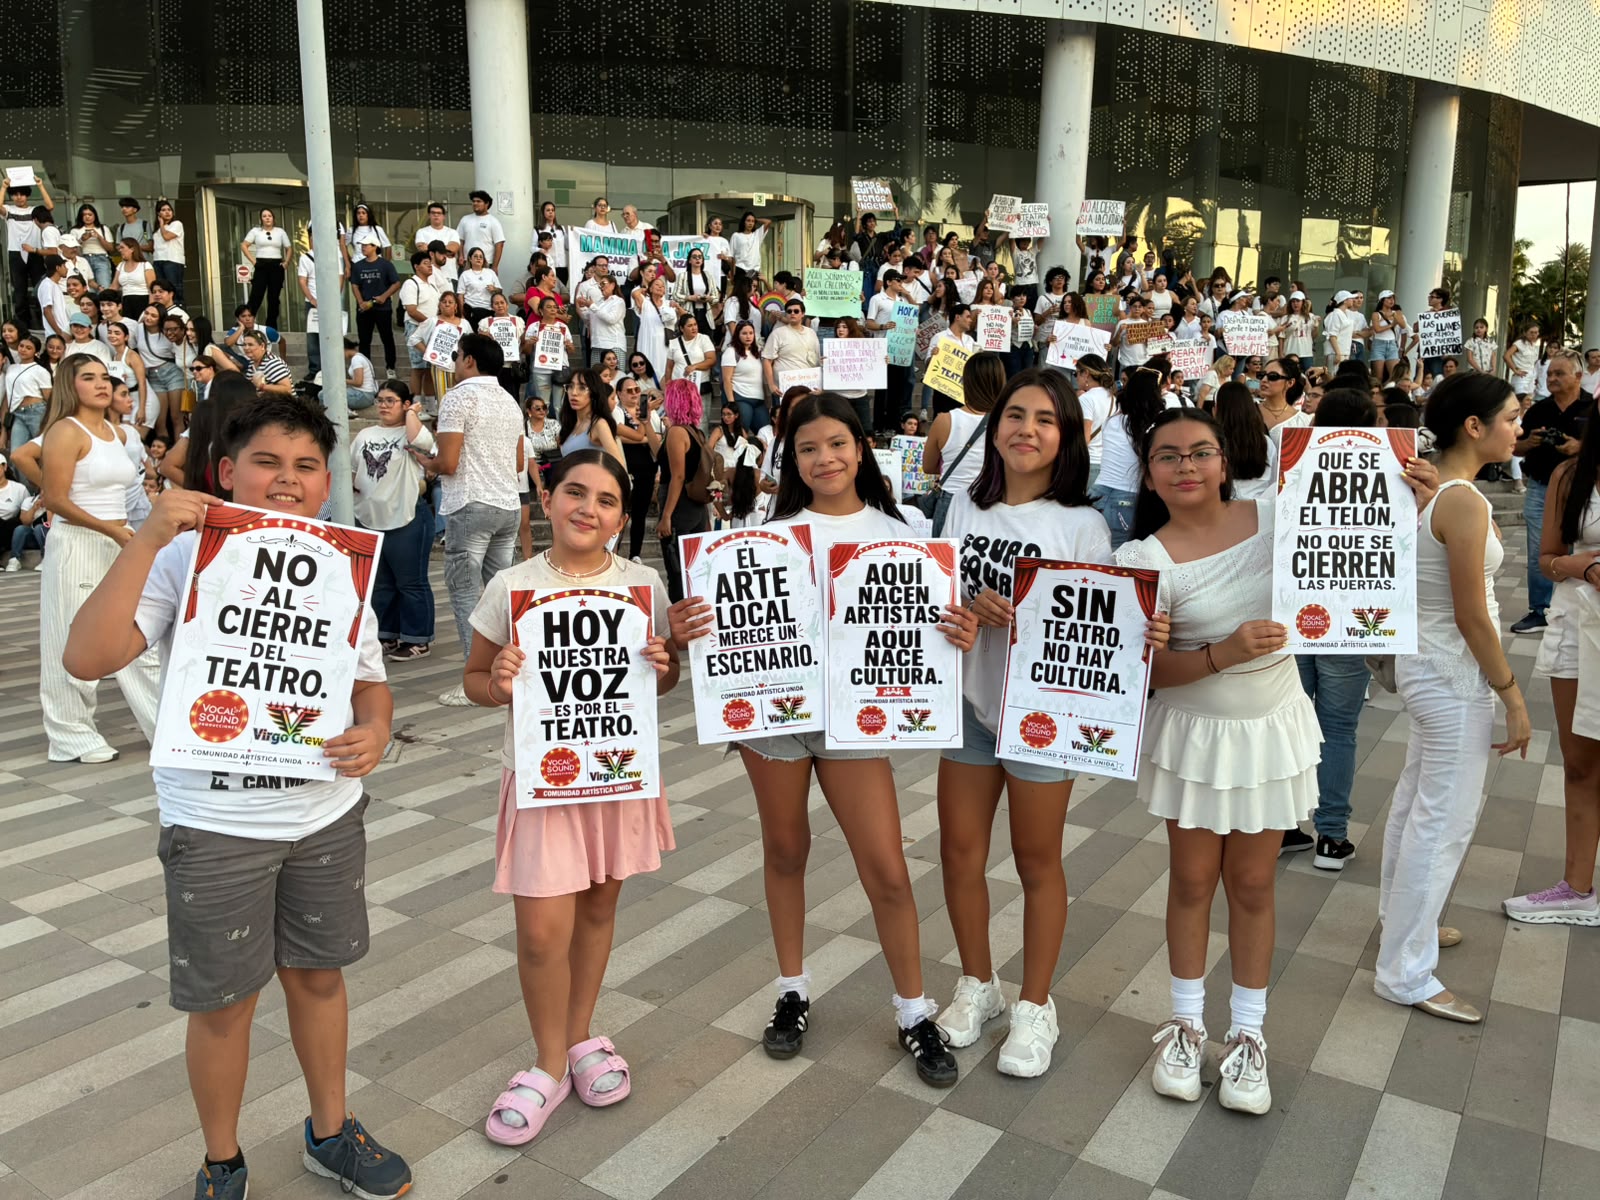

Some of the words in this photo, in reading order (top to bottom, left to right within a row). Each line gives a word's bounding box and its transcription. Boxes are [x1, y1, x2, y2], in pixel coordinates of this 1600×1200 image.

[757, 195, 763, 203] 3
[580, 234, 638, 256] MAMMA
[897, 306, 913, 316] HOY
[986, 314, 1008, 323] TEATRO
[435, 338, 454, 348] EXIGE
[543, 330, 546, 338] EL
[548, 331, 562, 340] TEATRO
[985, 339, 1002, 348] ARTE
[952, 347, 969, 361] ARTE
[892, 438, 903, 449] EL
[1318, 452, 1353, 470] QUE
[1359, 452, 1380, 470] SE
[906, 481, 916, 490] AL
[1306, 472, 1390, 504] ABRA
[1300, 506, 1321, 526] EL
[1328, 502, 1396, 529] TELÓN,
[1297, 534, 1321, 550] NO
[1328, 534, 1365, 550] QUE
[1371, 534, 1393, 550] SE
[252, 546, 318, 587] NO
[737, 547, 761, 570] EL
[1292, 551, 1396, 579] CIERREN
[865, 558, 923, 586] AQUÍ
[716, 566, 790, 604] ARTE
[1298, 580, 1325, 591] LAS
[1330, 580, 1396, 591] PUERTAS.
[261, 586, 297, 611] AL
[858, 586, 929, 605] NACEN
[1051, 584, 1116, 624] SIN
[716, 599, 796, 630] LOCAL
[217, 604, 332, 648] CIERRE
[543, 609, 625, 648] HOY
[1043, 619, 1124, 650] TEATRO,
[1346, 627, 1371, 639] Virgo
[1373, 626, 1396, 636] Crew
[719, 629, 774, 648] MERECE
[778, 624, 797, 640] UN
[865, 628, 921, 649] AQUÍ
[1340, 640, 1368, 648] ARTÍSTICA
[250, 642, 286, 662] DEL
[538, 647, 630, 669] NUESTRA
[706, 644, 818, 677] ESCENARIO.
[864, 649, 924, 667] NACE
[1043, 642, 1069, 663] NO
[1076, 647, 1114, 669] HAY
[205, 655, 328, 699] TEATRO.
[540, 667, 629, 703] VOZ
[850, 667, 943, 685] CULTURA.
[1031, 662, 1126, 695] CULTURA.
[721, 690, 755, 700] COMUNIDAD
[756, 687, 785, 696] ARTÍSTICA
[786, 685, 803, 693] UNIDA
[202, 703, 236, 716] VOCAL
[555, 705, 570, 717] ES
[576, 703, 601, 716] POR
[606, 702, 620, 713] EL
[728, 706, 746, 714] VOCAL
[768, 713, 789, 724] Virgo
[791, 711, 812, 720] Crew
[199, 713, 239, 725] SOUND
[541, 715, 638, 741] TEATRO.
[1027, 721, 1047, 730] VOCAL
[253, 728, 289, 745] Virgo
[292, 732, 324, 746] Crew
[897, 724, 917, 733] Virgo
[1025, 727, 1051, 736] SOUND
[191, 749, 239, 760] COMUNIDAD
[240, 752, 278, 763] ARTÍSTICA
[279, 756, 302, 766] UNIDA
[1017, 747, 1058, 759] COMUNIDAD
[1059, 753, 1092, 764] ARTÍSTICA
[1094, 759, 1115, 767] UNIDA
[1071, 741, 1094, 753] Virgo
[1095, 744, 1118, 756] Crew
[547, 758, 570, 766] VOCAL
[547, 765, 575, 773] SOUND
[242, 775, 281, 789] CAN
[590, 771, 615, 782] Virgo
[617, 769, 642, 779] Crew
[543, 788, 580, 797] COMUNIDAD
[582, 785, 614, 795] ARTÍSTICA
[615, 784, 634, 792] UNIDA
